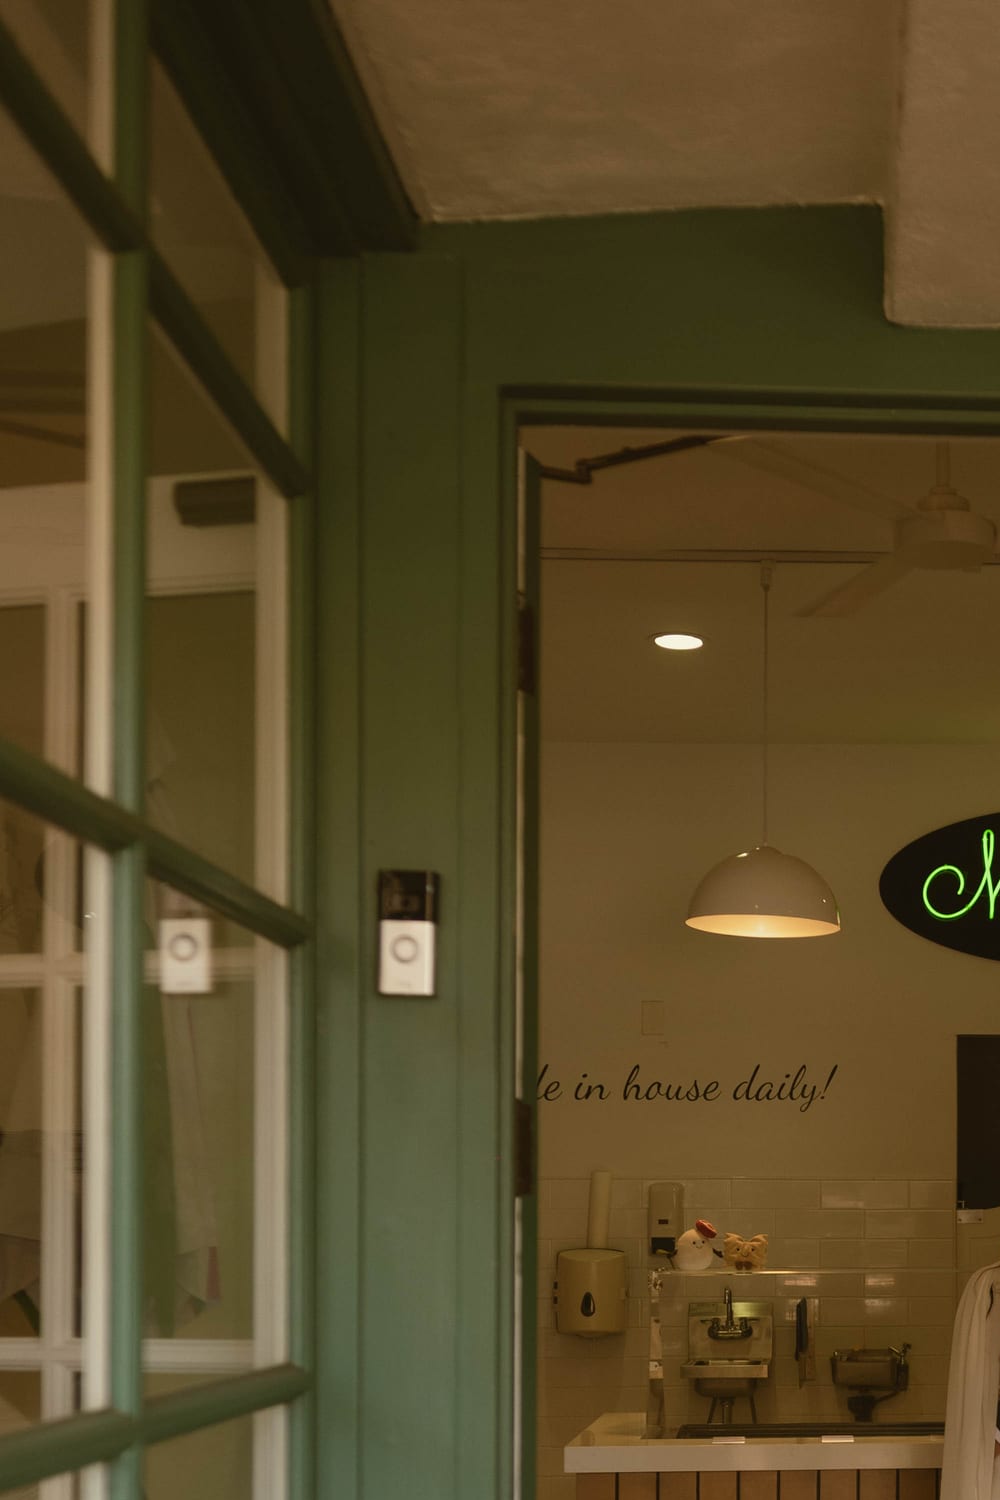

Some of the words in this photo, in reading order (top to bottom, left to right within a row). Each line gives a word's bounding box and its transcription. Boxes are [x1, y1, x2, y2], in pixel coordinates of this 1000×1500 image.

[574, 1073, 610, 1101] in
[622, 1063, 721, 1102] house
[732, 1063, 839, 1113] daily!
